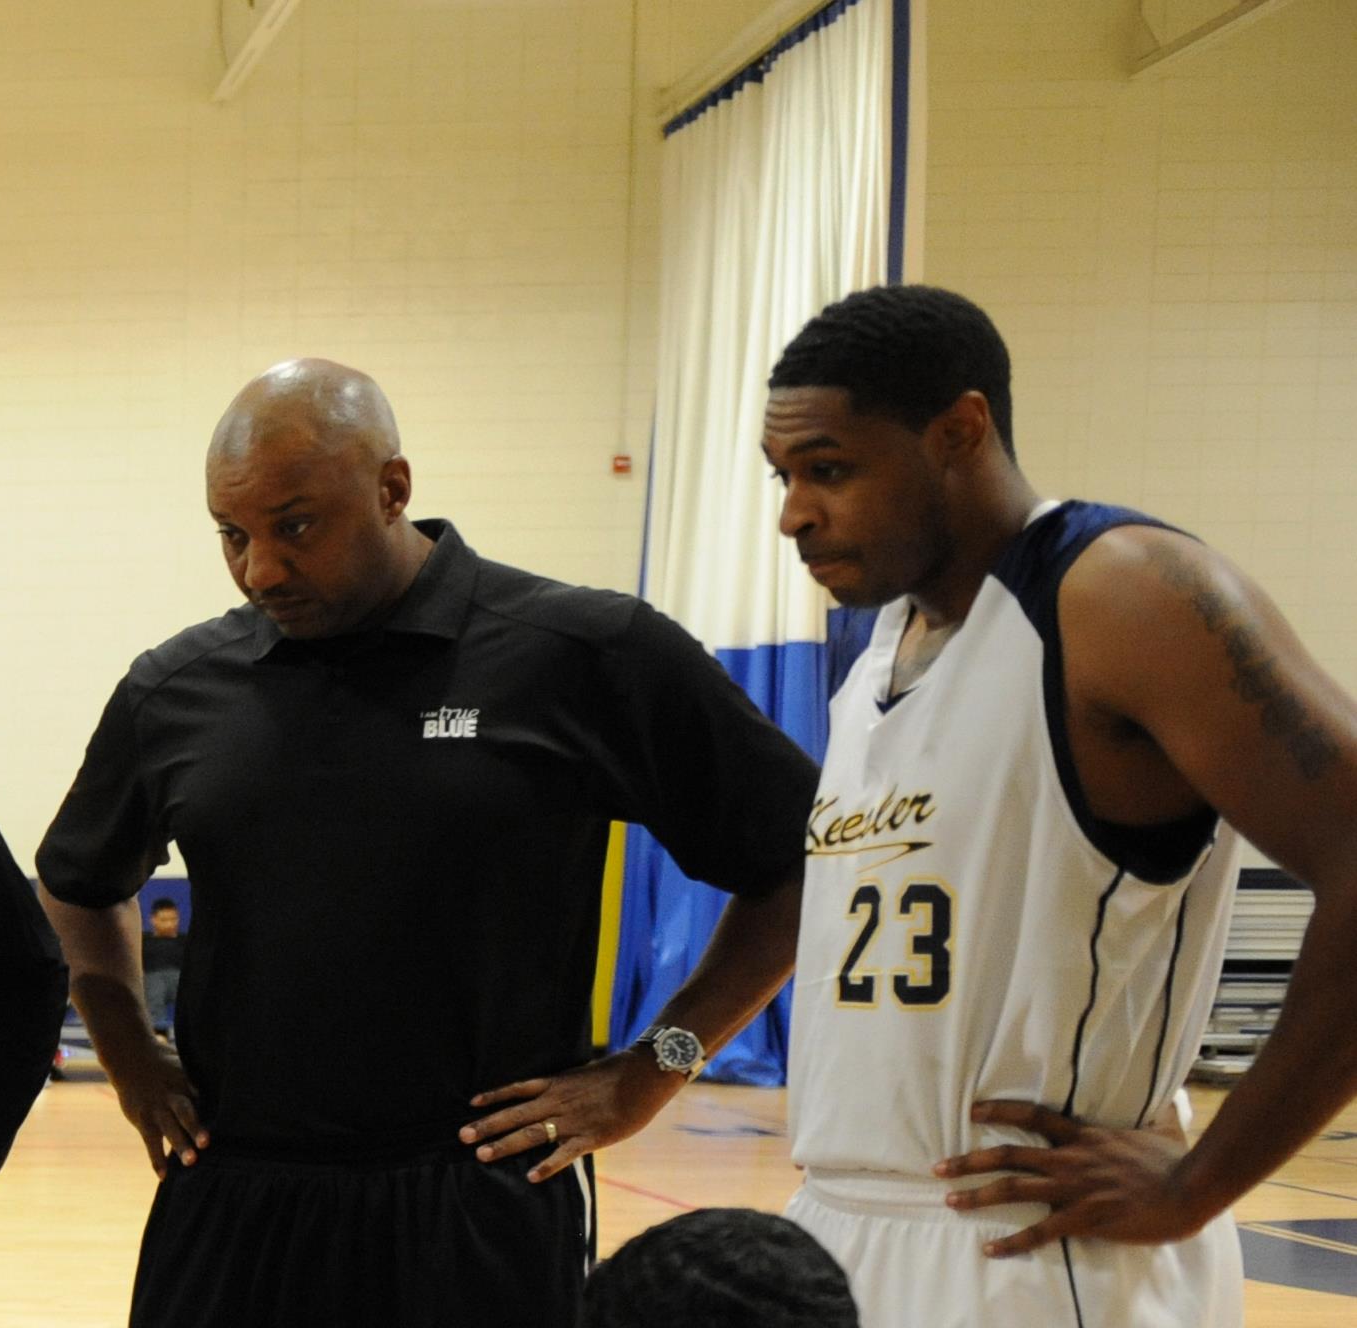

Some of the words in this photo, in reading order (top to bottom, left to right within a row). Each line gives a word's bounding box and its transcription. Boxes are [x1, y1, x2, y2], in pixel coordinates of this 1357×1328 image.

[423, 719, 478, 739] BLUE
[439, 705, 480, 720] true
[804, 783, 938, 848] Keeler
[835, 877, 959, 1011] 23
